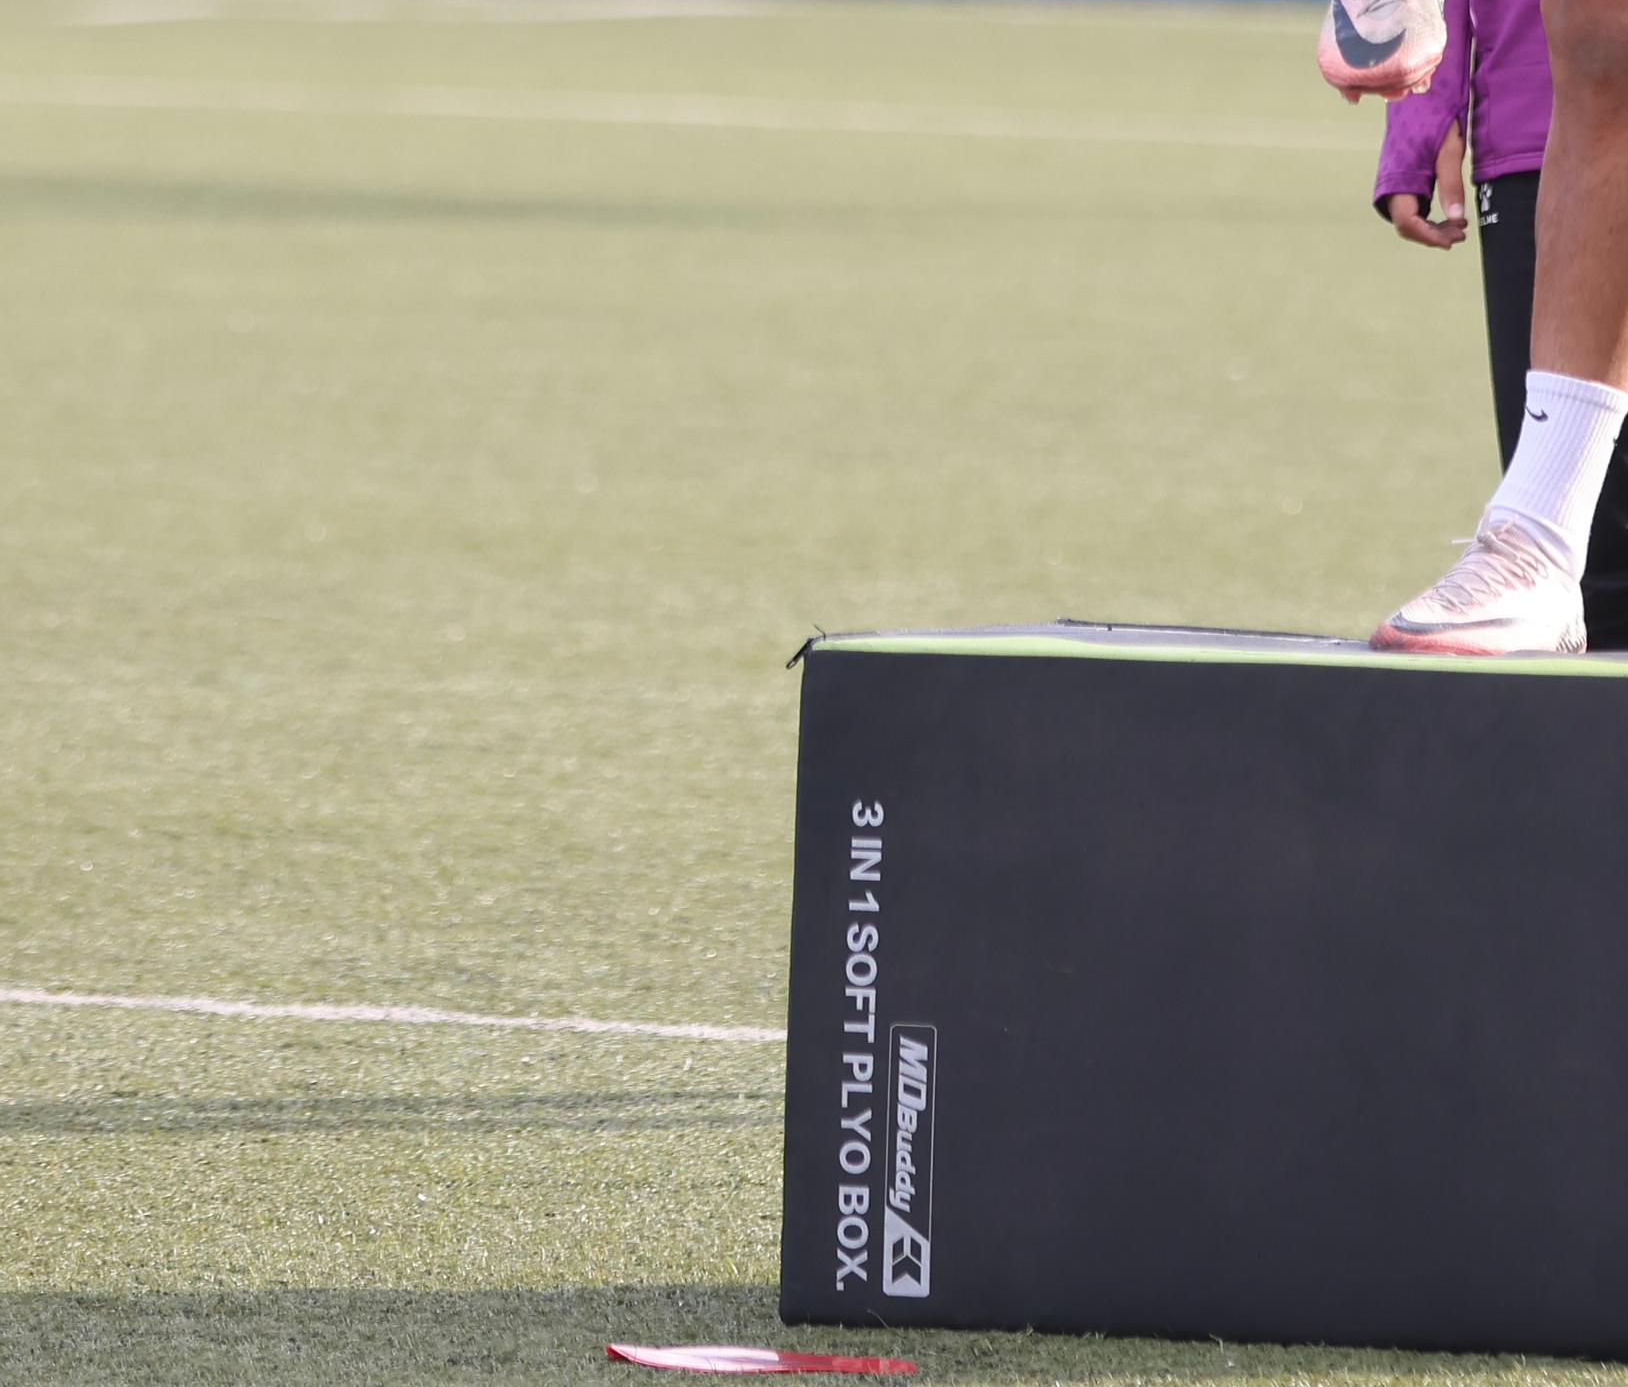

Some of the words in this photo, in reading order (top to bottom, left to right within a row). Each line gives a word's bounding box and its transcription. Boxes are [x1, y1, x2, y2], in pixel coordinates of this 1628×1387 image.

[849, 837, 883, 883] IN
[851, 799, 885, 828] 3
[848, 892, 880, 913] 1
[843, 923, 880, 1044] SOFT
[838, 1052, 874, 1174] PLYO
[888, 1034, 929, 1213] MDBuddy
[834, 1185, 870, 1293] BOX.
